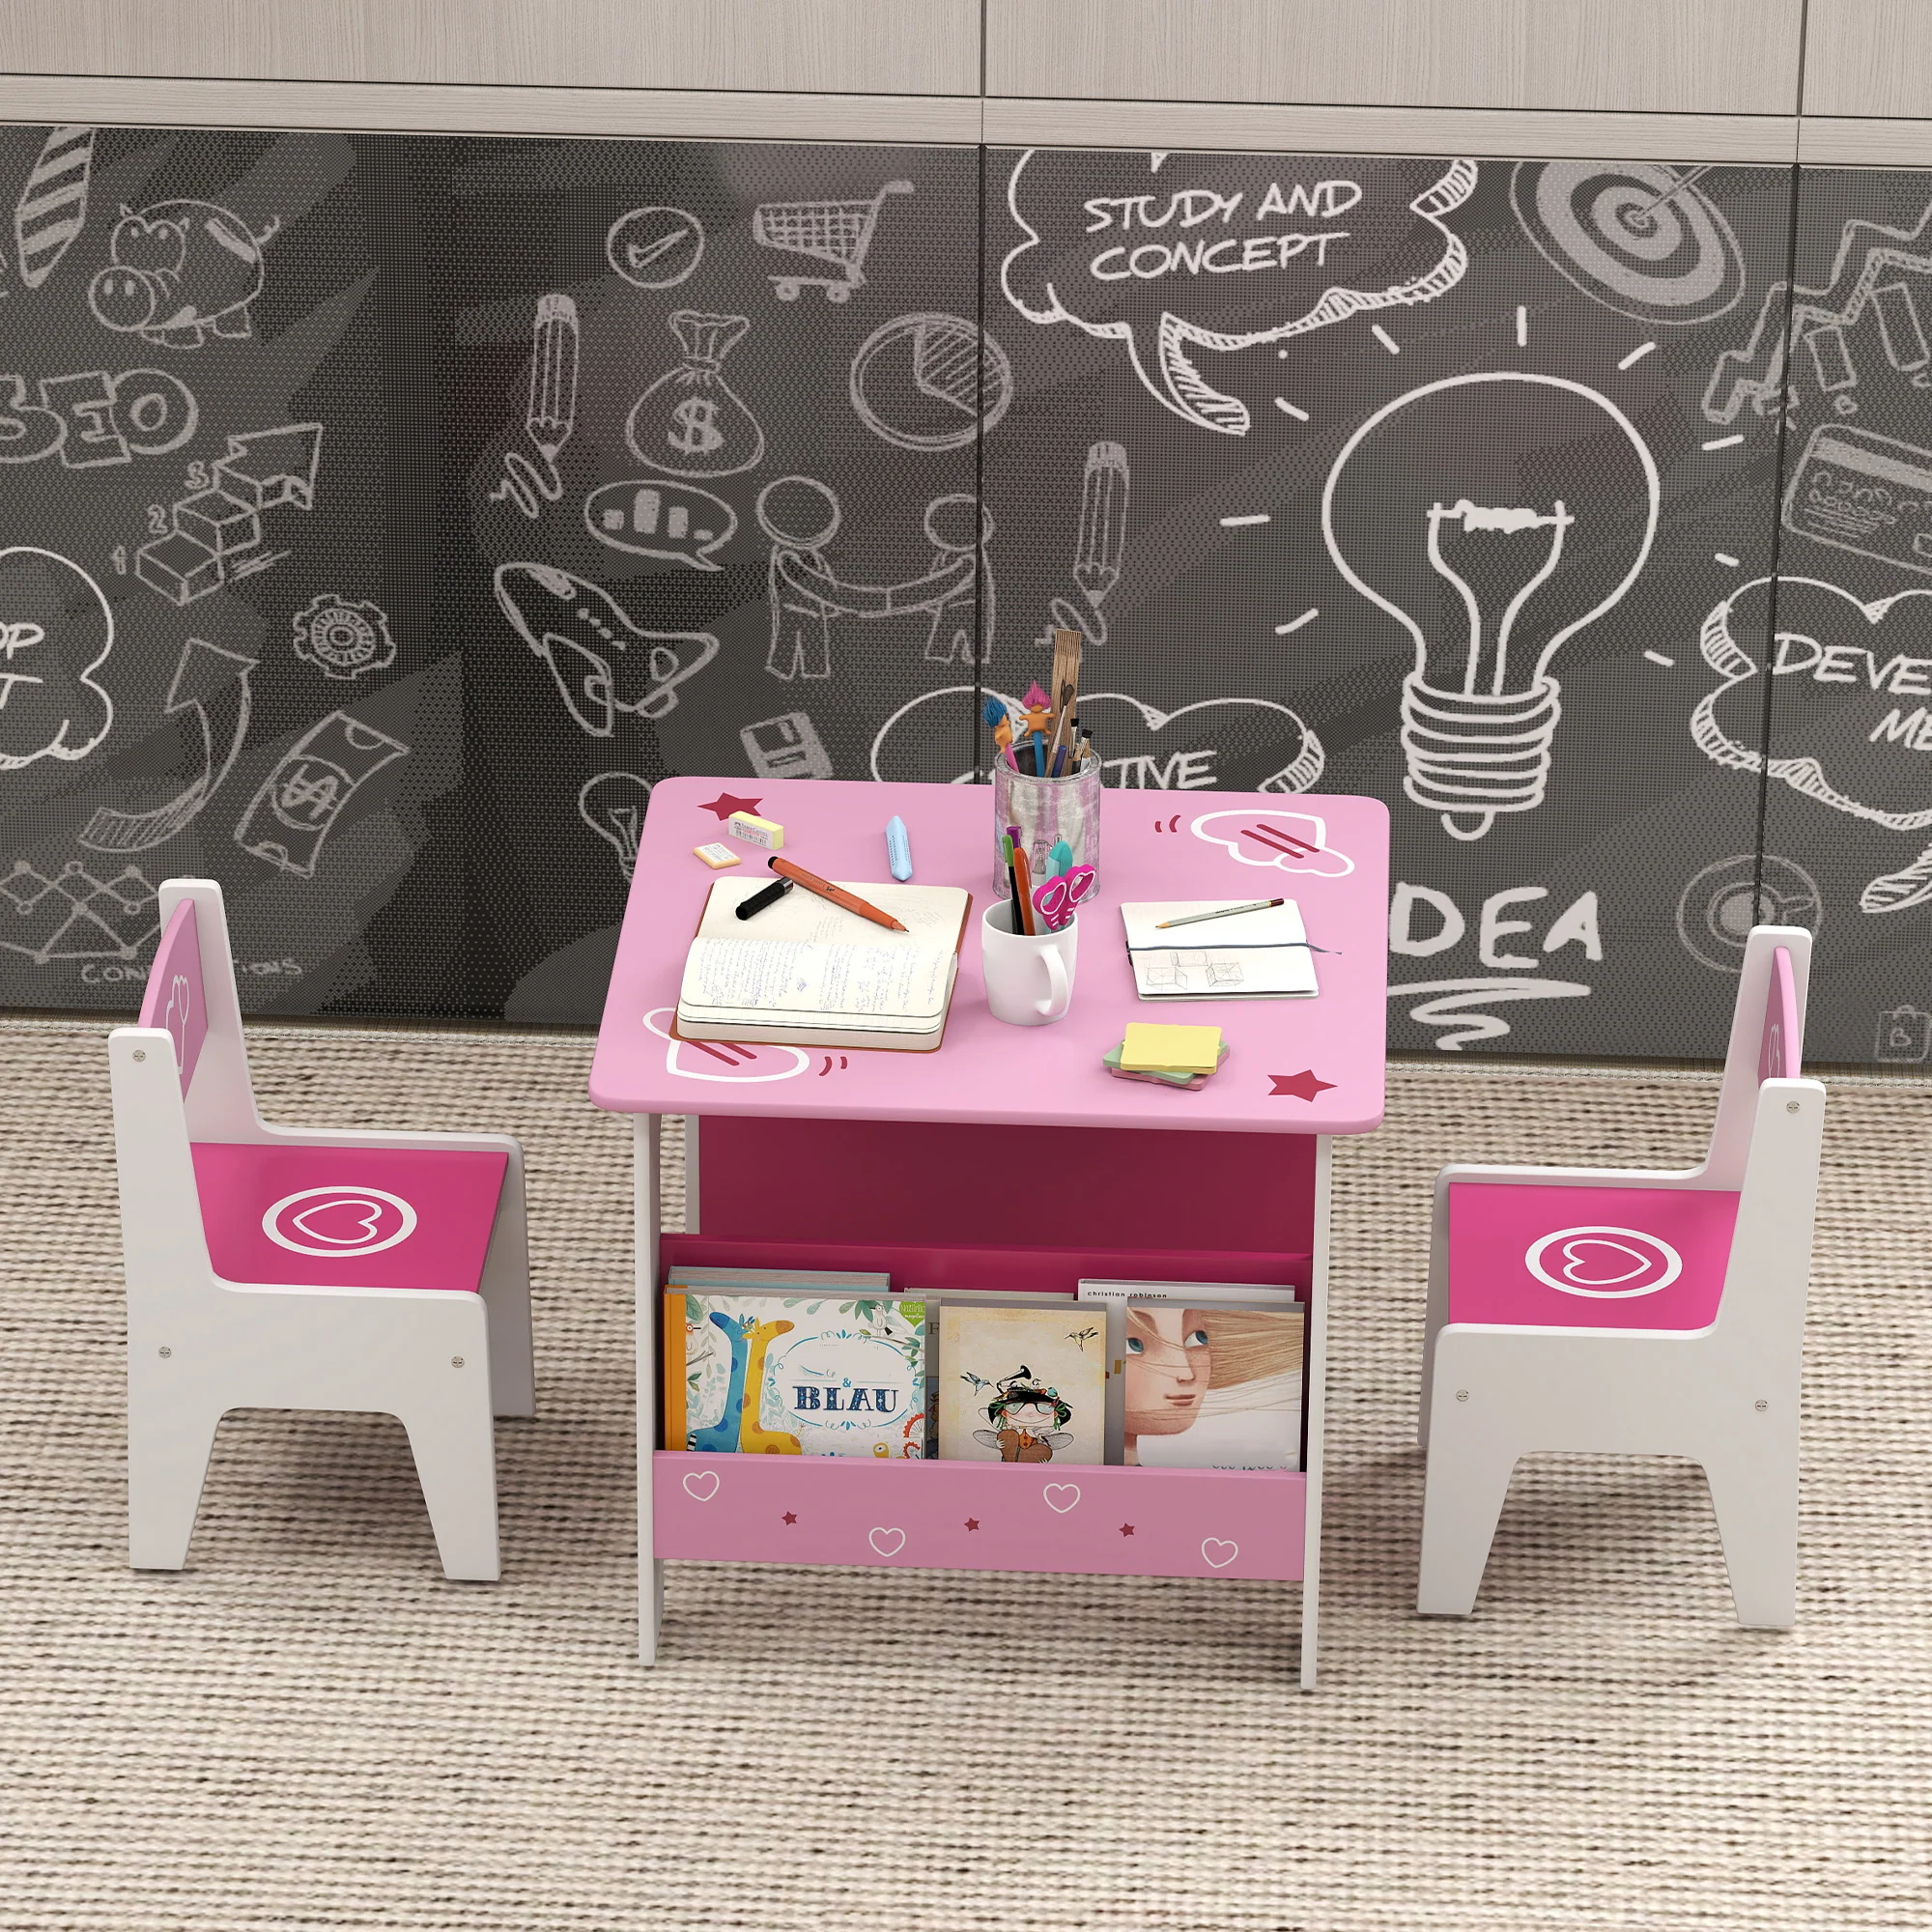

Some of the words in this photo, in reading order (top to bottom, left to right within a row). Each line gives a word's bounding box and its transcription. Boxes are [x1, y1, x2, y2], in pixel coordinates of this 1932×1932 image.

[1084, 189, 1242, 233] STUDY
[1257, 180, 1363, 220] AND
[1090, 231, 1350, 281] CONCEPT
[1772, 632, 1932, 695] DEVE
[1388, 880, 1604, 970] DEA
[792, 1385, 899, 1413] BLAU
[842, 1378, 852, 1388] &
